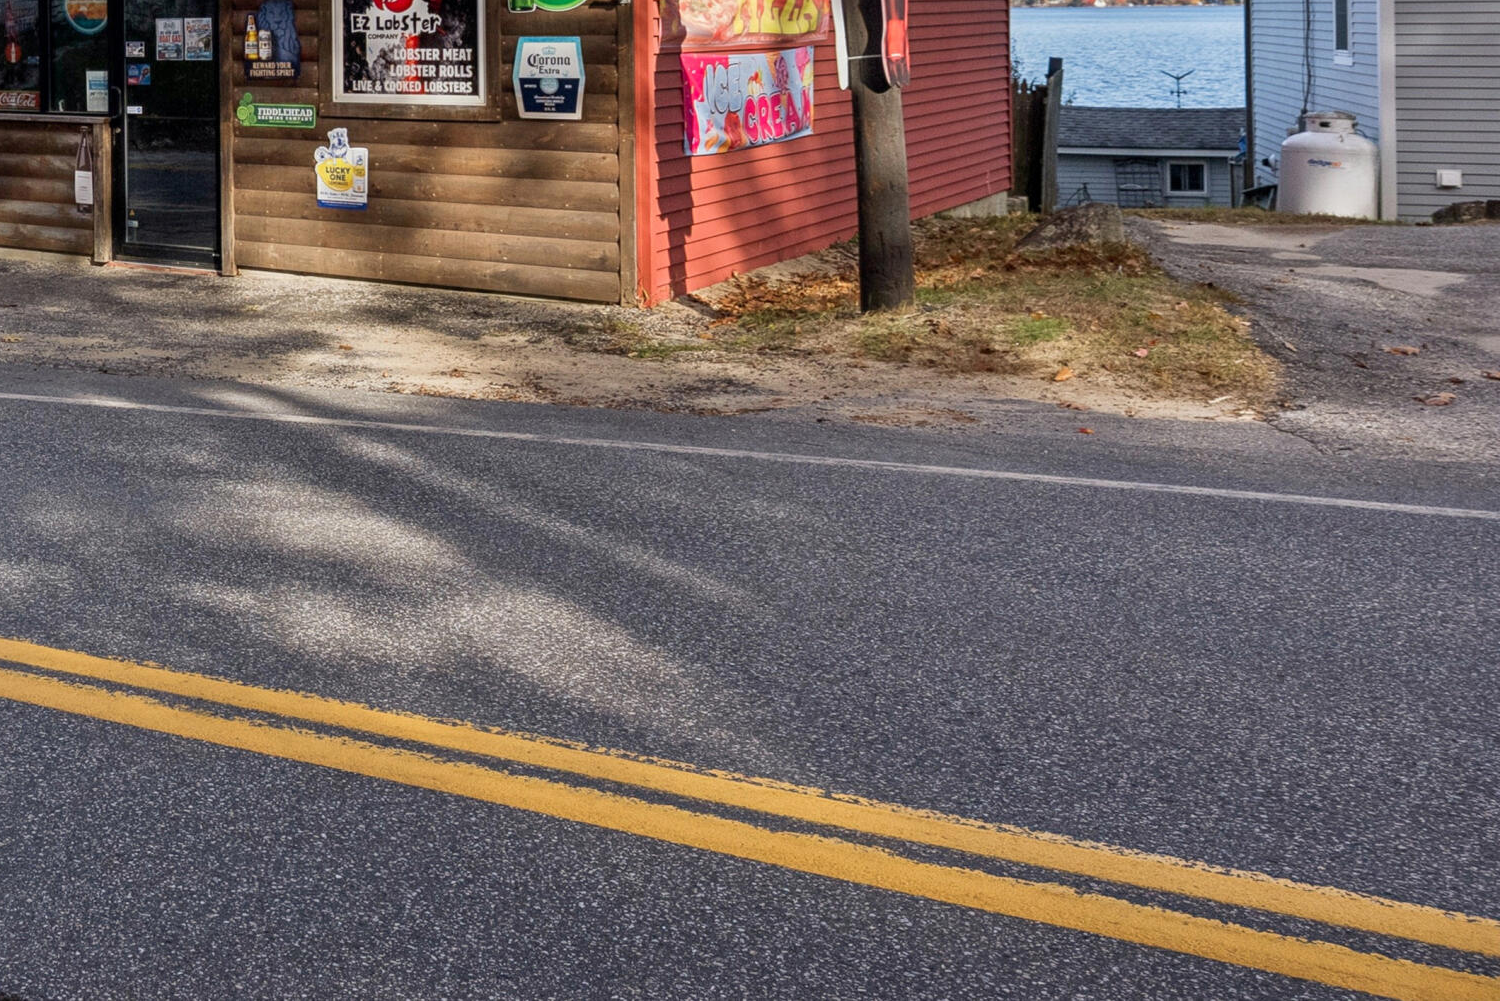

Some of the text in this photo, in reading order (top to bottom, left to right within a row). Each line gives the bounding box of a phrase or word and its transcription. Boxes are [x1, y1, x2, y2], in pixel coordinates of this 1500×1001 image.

[394, 48, 473, 61] LOBSTER MEAT
[253, 61, 292, 70] REWARD YOUR
[527, 53, 571, 69] Corona
[250, 68, 295, 78] FIGHTING SPIRIT
[390, 64, 473, 78] LOBSTER ROLLS
[539, 65, 560, 75] Extra
[352, 80, 473, 93] LIVE & COOKED LOBSTERS
[705, 62, 743, 114] ICE
[257, 107, 313, 117] FIDDLEHEAD
[743, 85, 812, 145] CREAM
[325, 166, 351, 175] LUCKY
[329, 173, 347, 182] ONE
